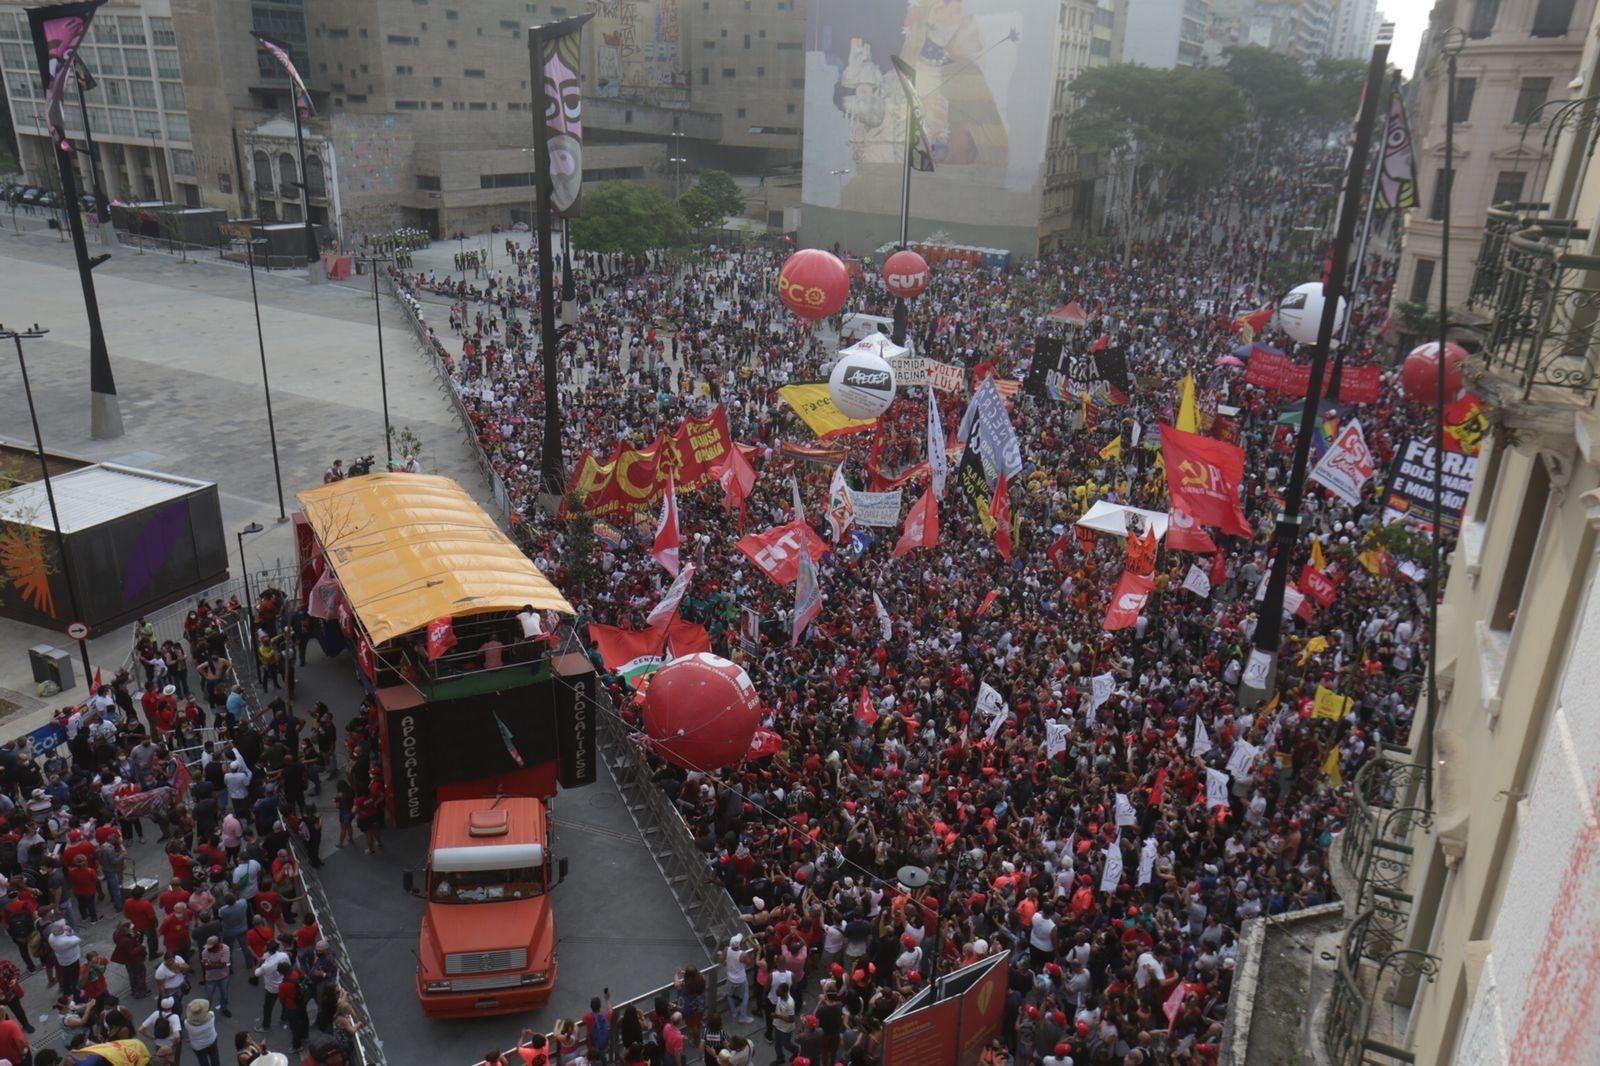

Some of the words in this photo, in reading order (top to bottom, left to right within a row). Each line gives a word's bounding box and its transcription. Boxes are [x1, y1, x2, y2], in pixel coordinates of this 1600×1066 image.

[778, 275, 826, 307] PCO
[888, 271, 926, 290] CUT
[891, 360, 925, 369] COMIDA
[934, 362, 963, 379] VOLTA
[934, 373, 961, 393] LULA
[1404, 440, 1477, 478] FORA
[1400, 462, 1472, 493] BOLSNARO
[1393, 477, 1404, 490] E
[1405, 482, 1465, 510] MOUÃO!
[633, 658, 664, 666] CENTR
[574, 681, 586, 779] APOCALIPSE
[401, 715, 420, 818] APOCALIPSE
